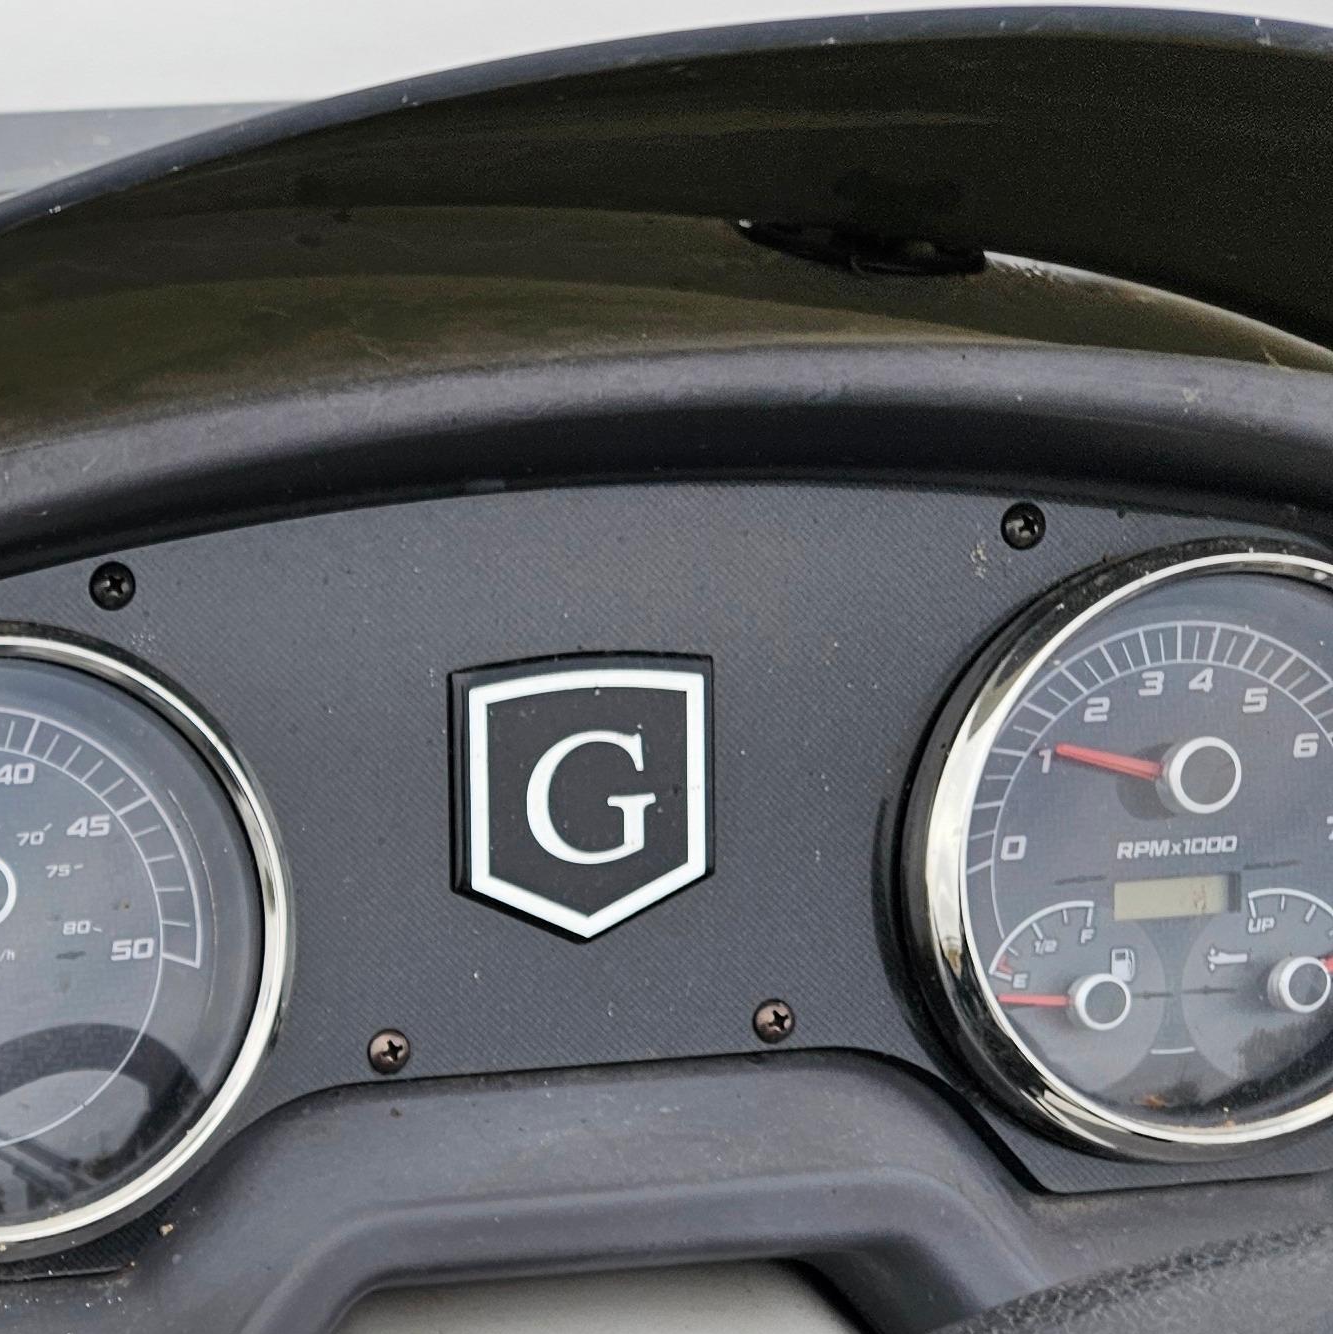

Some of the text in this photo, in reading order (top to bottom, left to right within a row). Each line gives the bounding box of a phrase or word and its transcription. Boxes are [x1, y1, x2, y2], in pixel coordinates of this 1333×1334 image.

[1138, 671, 1165, 696] 3
[1188, 667, 1214, 693] 4
[1083, 697, 1110, 722] 2
[1242, 687, 1269, 713] 5
[1293, 732, 1320, 758] 6
[1038, 750, 1052, 773] 1
[526, 730, 656, 865] G
[66, 815, 111, 837] 45
[16, 831, 45, 846] 70
[1001, 835, 1027, 861] 0
[45, 864, 71, 878] 75
[63, 920, 91, 935] 80
[1081, 929, 1094, 944] F
[1248, 918, 1275, 933] UP
[111, 938, 155, 961] 50
[1013, 973, 1028, 989] E
